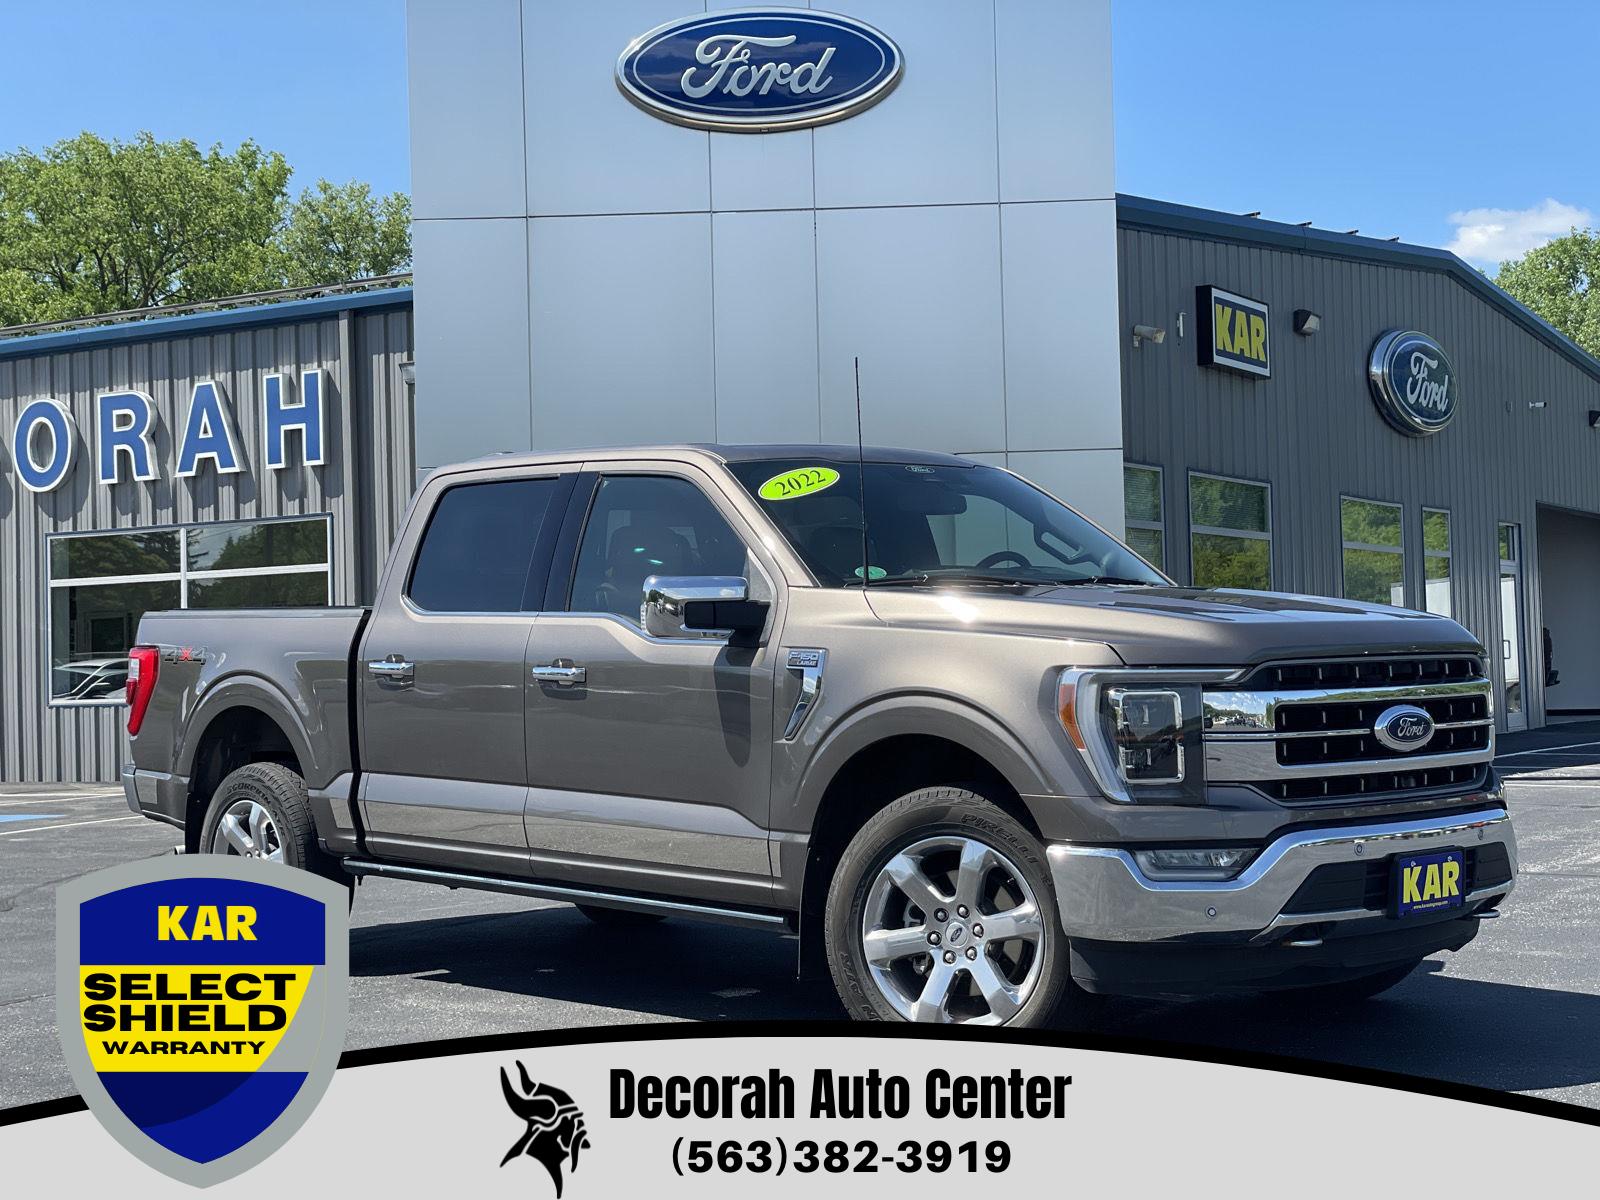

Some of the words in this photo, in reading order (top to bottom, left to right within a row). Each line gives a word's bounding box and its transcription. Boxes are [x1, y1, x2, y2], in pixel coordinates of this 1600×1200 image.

[681, 34, 836, 98] Ford
[1214, 303, 1266, 362] KAR
[1406, 351, 1448, 412] Ford
[13, 369, 329, 493] ORAH
[775, 470, 826, 496] 2022
[1397, 717, 1426, 737] Ford
[961, 813, 1039, 864] PIRELLI
[1403, 861, 1460, 903] KAR
